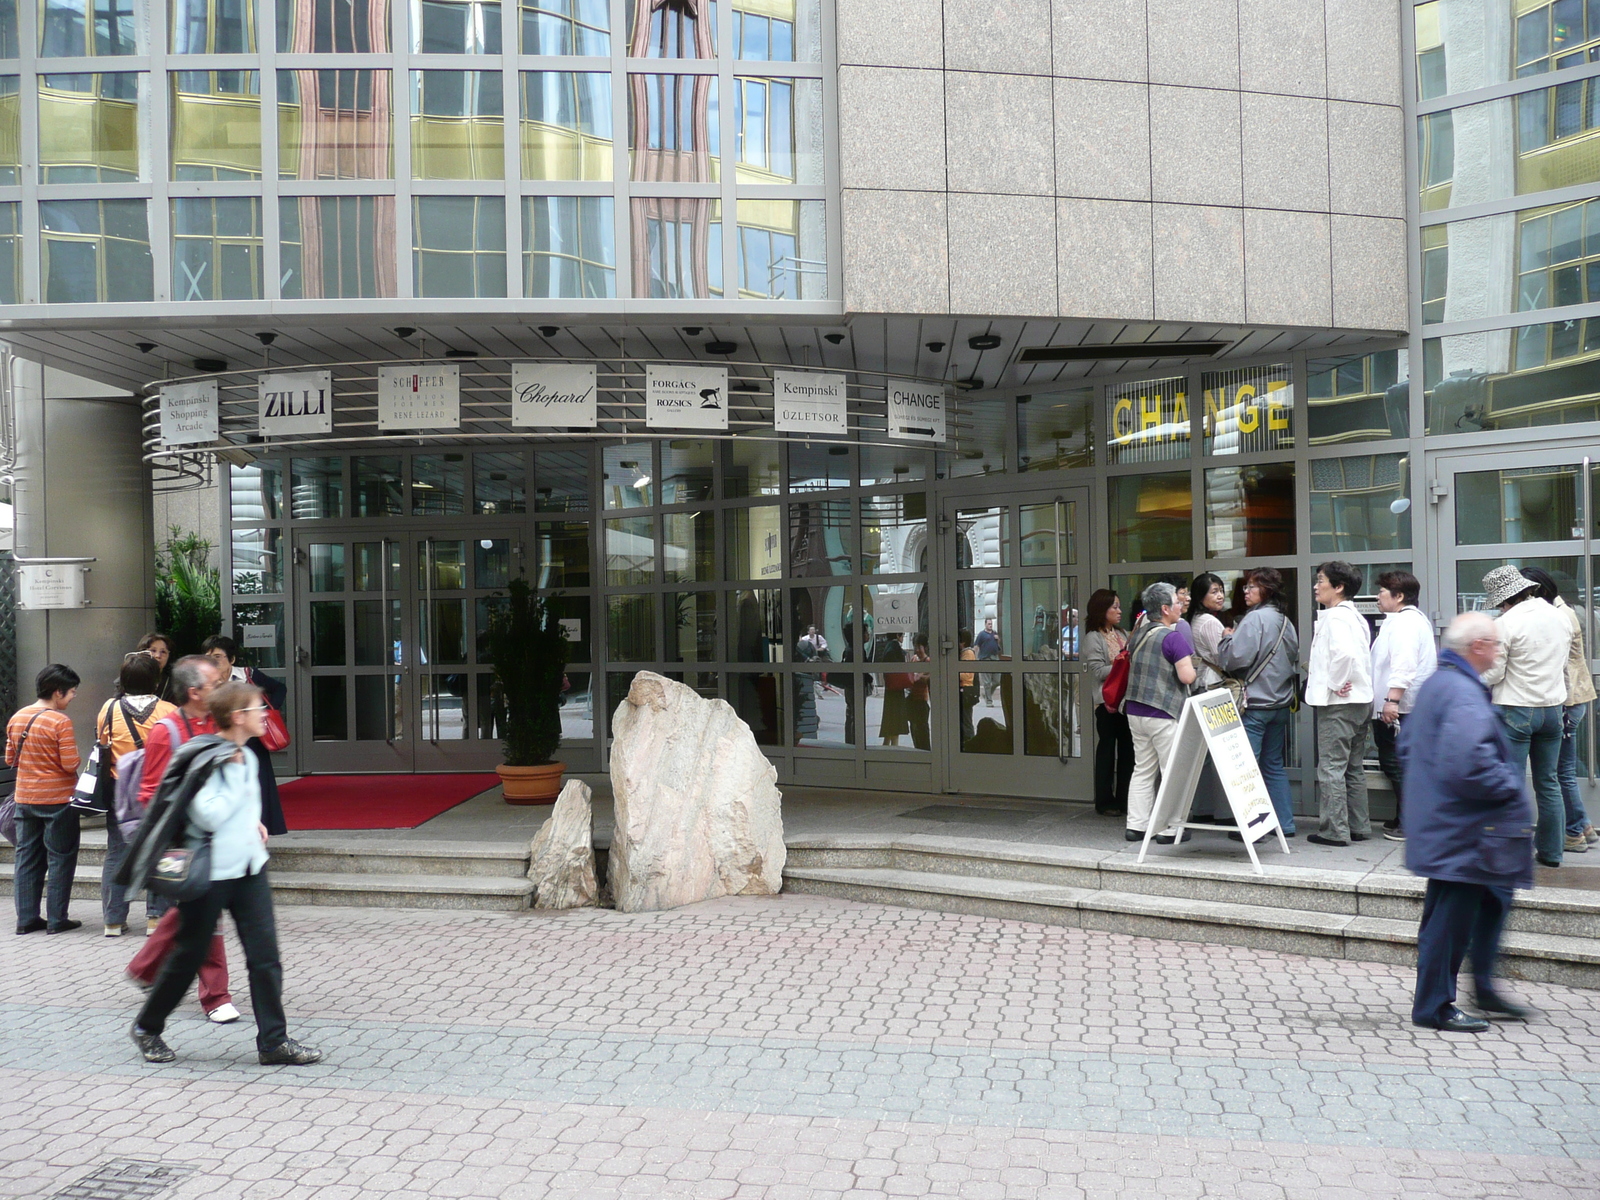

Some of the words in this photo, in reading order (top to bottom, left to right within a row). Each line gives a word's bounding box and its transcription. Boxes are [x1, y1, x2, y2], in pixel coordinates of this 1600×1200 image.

[393, 375, 444, 391] SCHIFFER
[652, 378, 697, 389] FORGÁCS
[783, 382, 839, 397] Kempinski
[167, 393, 211, 408] Kempinski
[514, 381, 594, 408] Chopard
[893, 390, 941, 410] CHANGE
[264, 388, 326, 418] ZILLI
[656, 398, 693, 407] ROZSICS
[169, 408, 209, 421] Shopping
[393, 410, 413, 419] RENÉ
[416, 410, 445, 418] LEZARD
[782, 410, 840, 423] ÜZLETSOR
[1113, 380, 1289, 446] CHANGE
[174, 420, 204, 432] Arcade
[877, 616, 914, 625] GARAGE
[1202, 700, 1239, 731] CHANGE
[1222, 732, 1239, 743] EURO
[1227, 742, 1240, 751] USD
[1231, 752, 1243, 761] GBP
